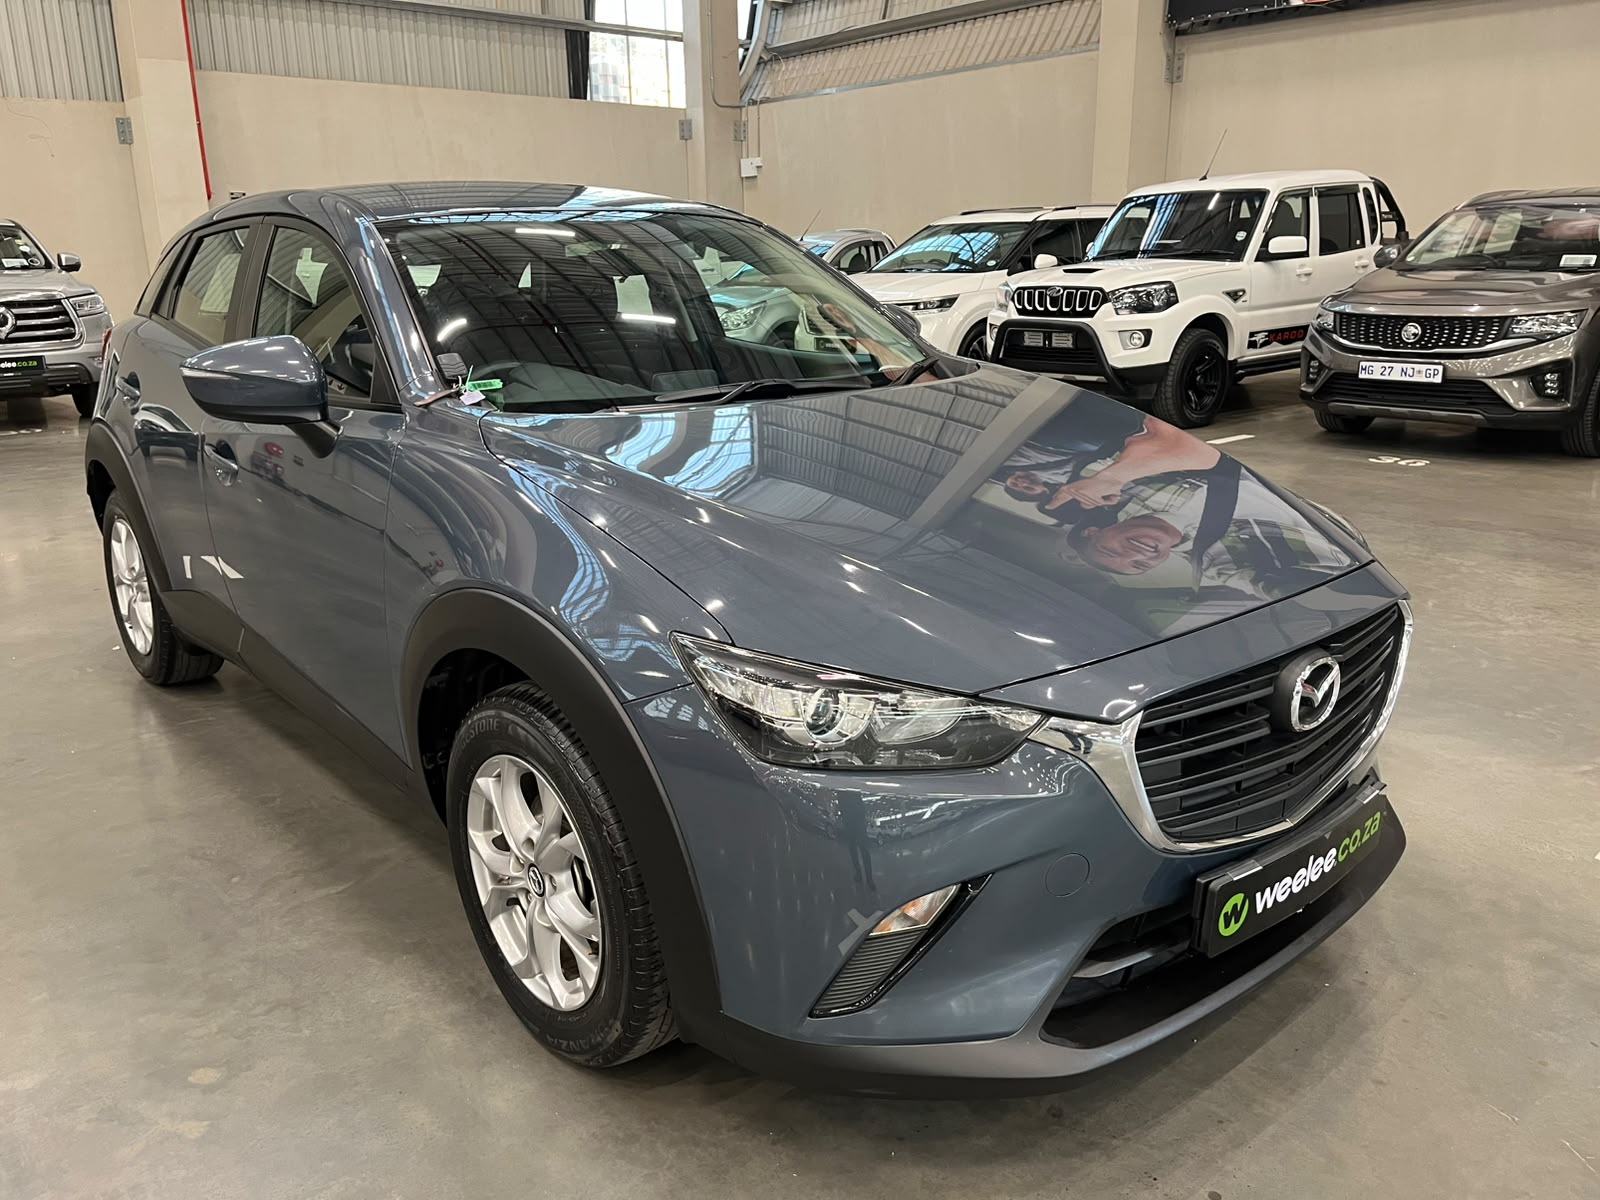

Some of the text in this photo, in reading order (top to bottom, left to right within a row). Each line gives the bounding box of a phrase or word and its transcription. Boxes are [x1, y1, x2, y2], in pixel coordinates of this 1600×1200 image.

[1360, 365, 1440, 379] MG 27 NJ GP
